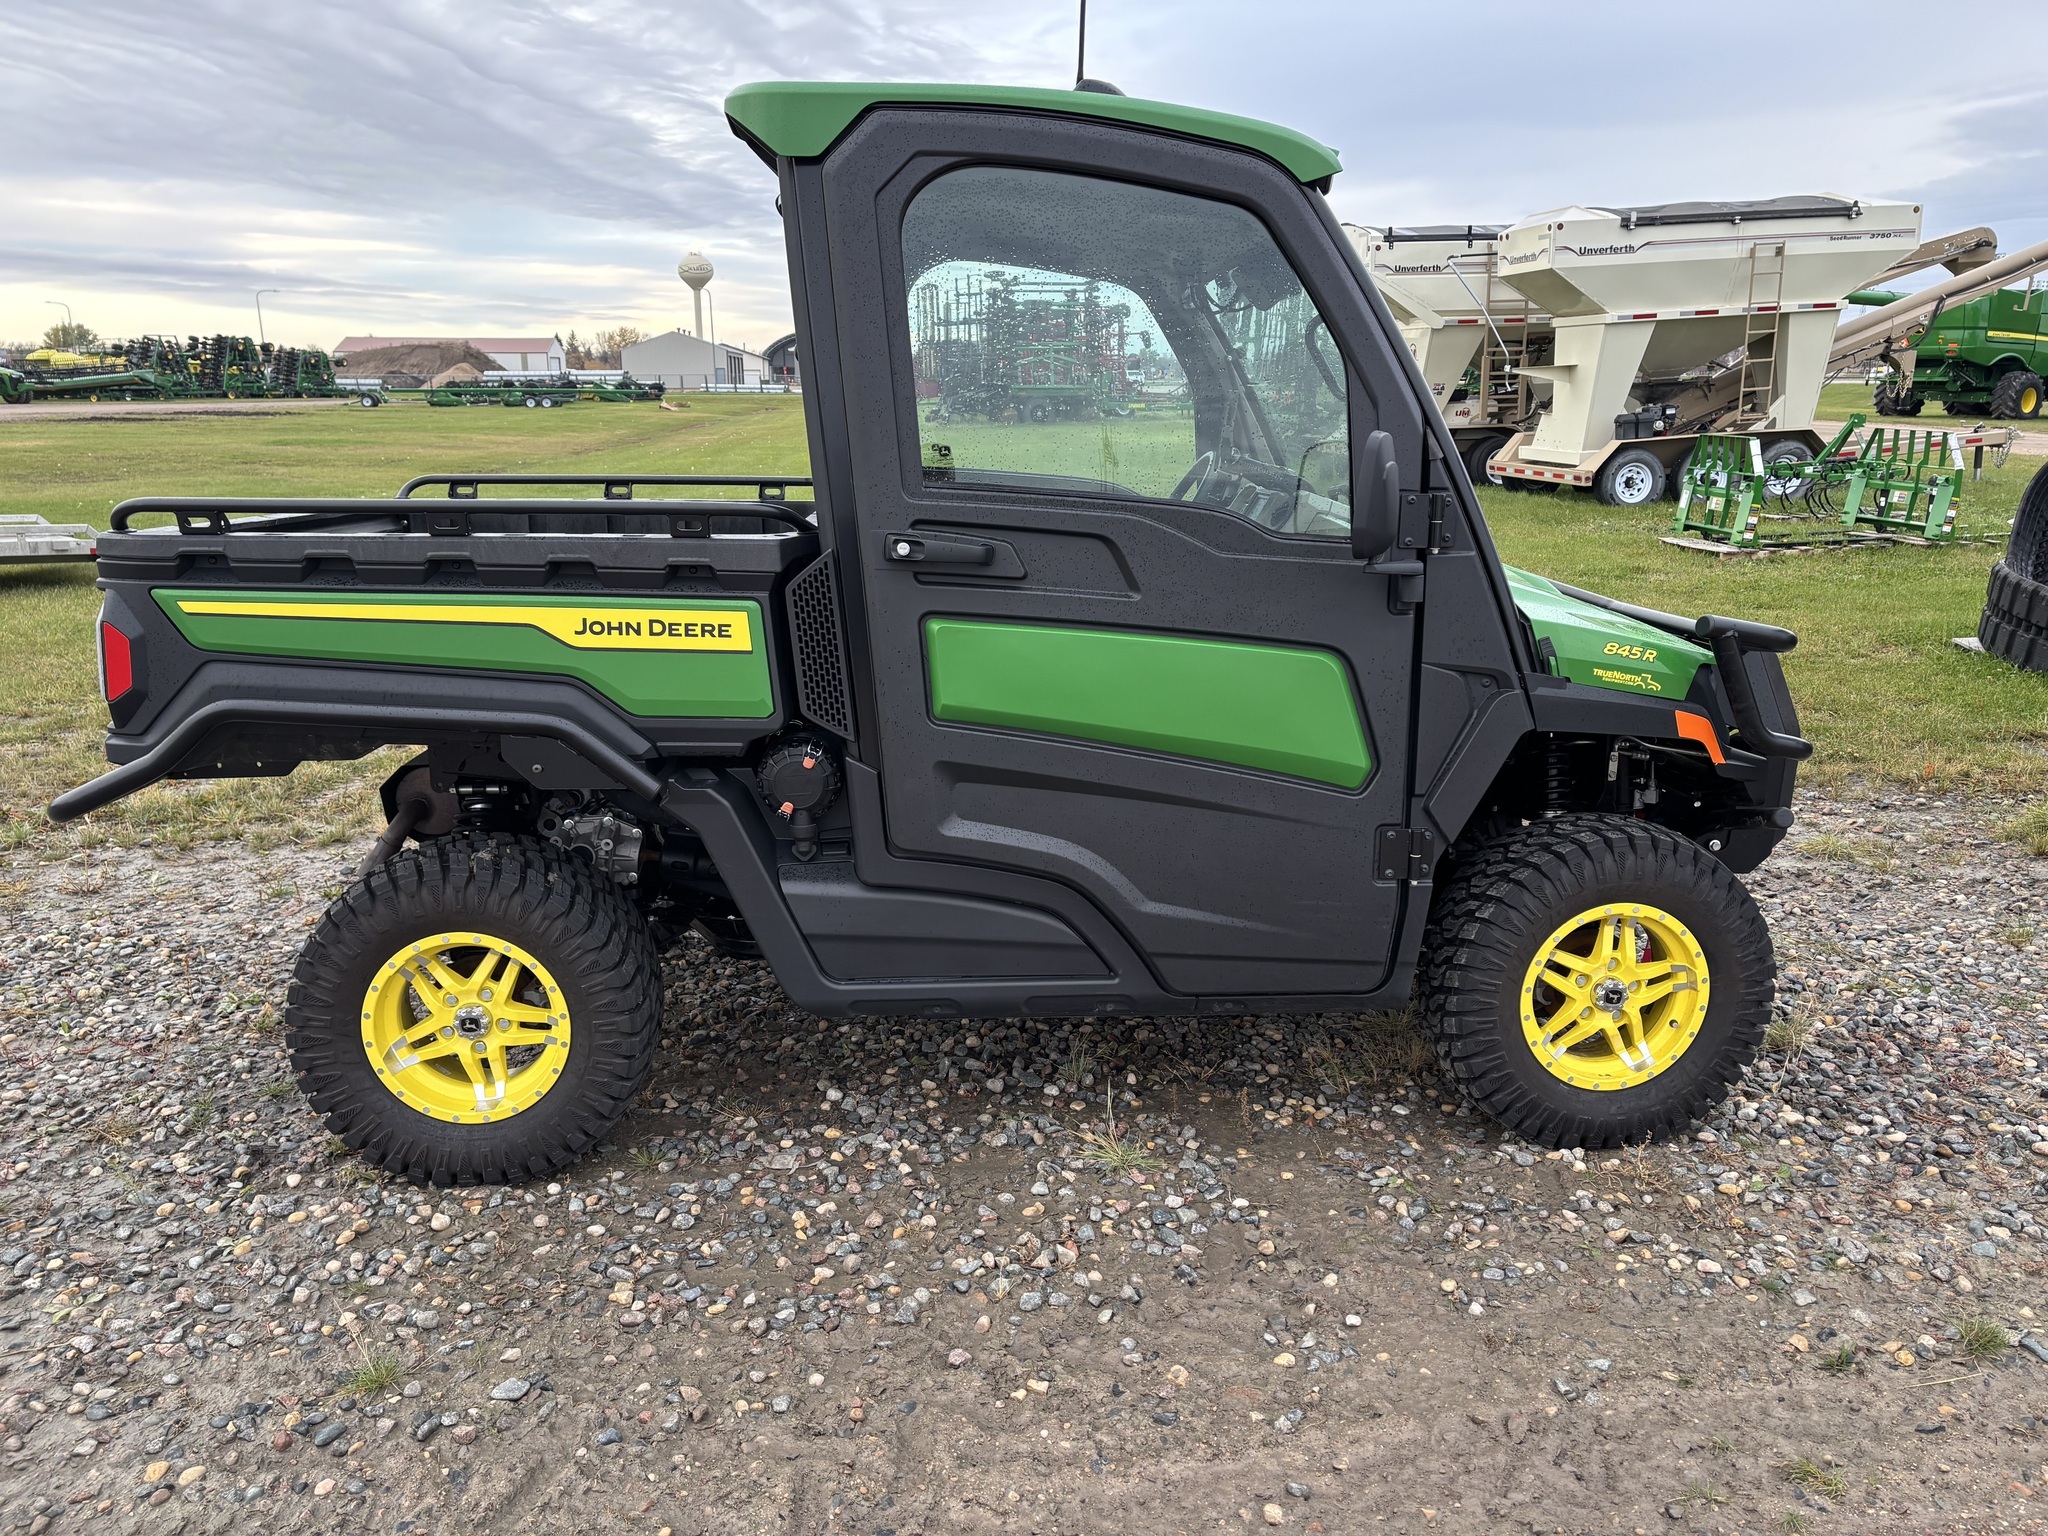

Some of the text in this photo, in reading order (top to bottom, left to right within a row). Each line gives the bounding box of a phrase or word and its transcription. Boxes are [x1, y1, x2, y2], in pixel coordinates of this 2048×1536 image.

[1579, 244, 1635, 255] Unverferth
[1509, 251, 1537, 264] Unverferth
[1394, 264, 1442, 272] Unverferth
[574, 617, 733, 639] JOHN DEERE
[1603, 641, 1658, 663] 845R
